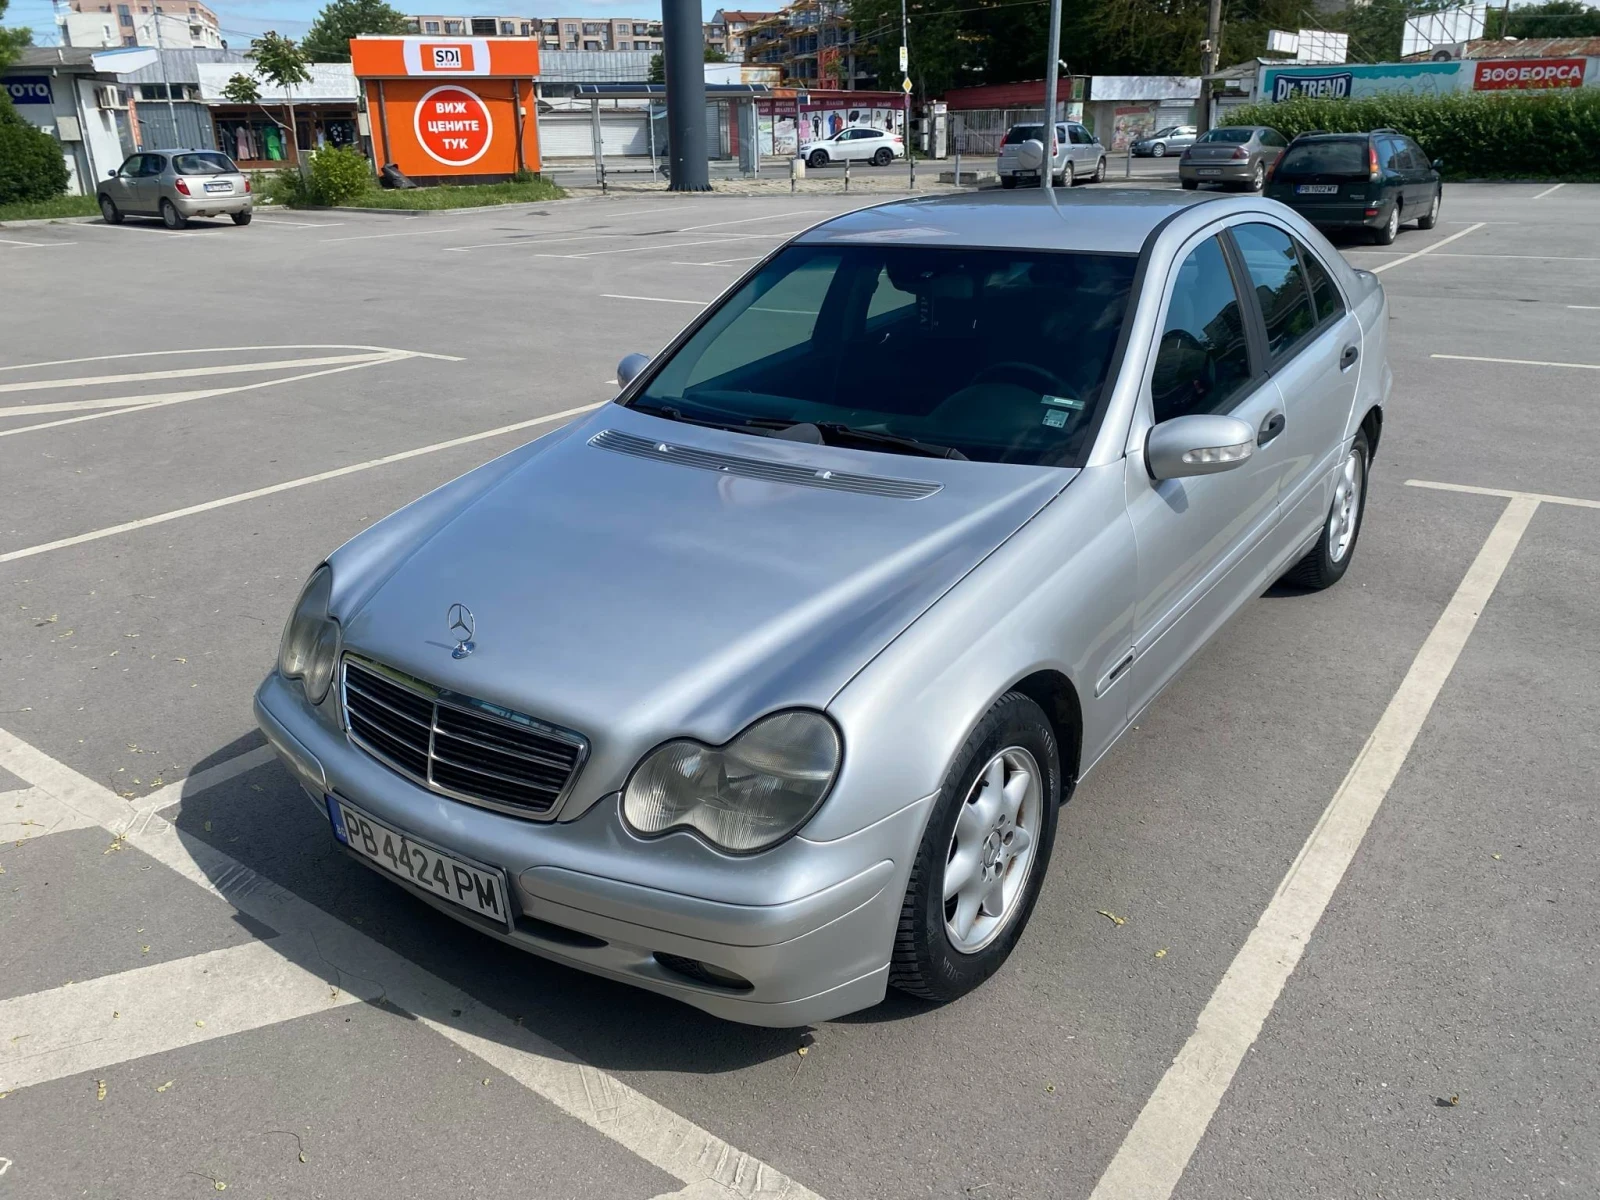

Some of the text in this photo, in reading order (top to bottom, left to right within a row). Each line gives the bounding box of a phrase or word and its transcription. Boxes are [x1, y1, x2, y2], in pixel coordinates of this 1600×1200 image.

[435, 50, 459, 62] SDI
[1481, 66, 1582, 82] ЗООБОРСА
[1300, 77, 1347, 99] TREND
[436, 102, 467, 113] ВИЖ
[427, 120, 480, 134] ЦЕНИТЕ
[442, 138, 469, 149] ТУК
